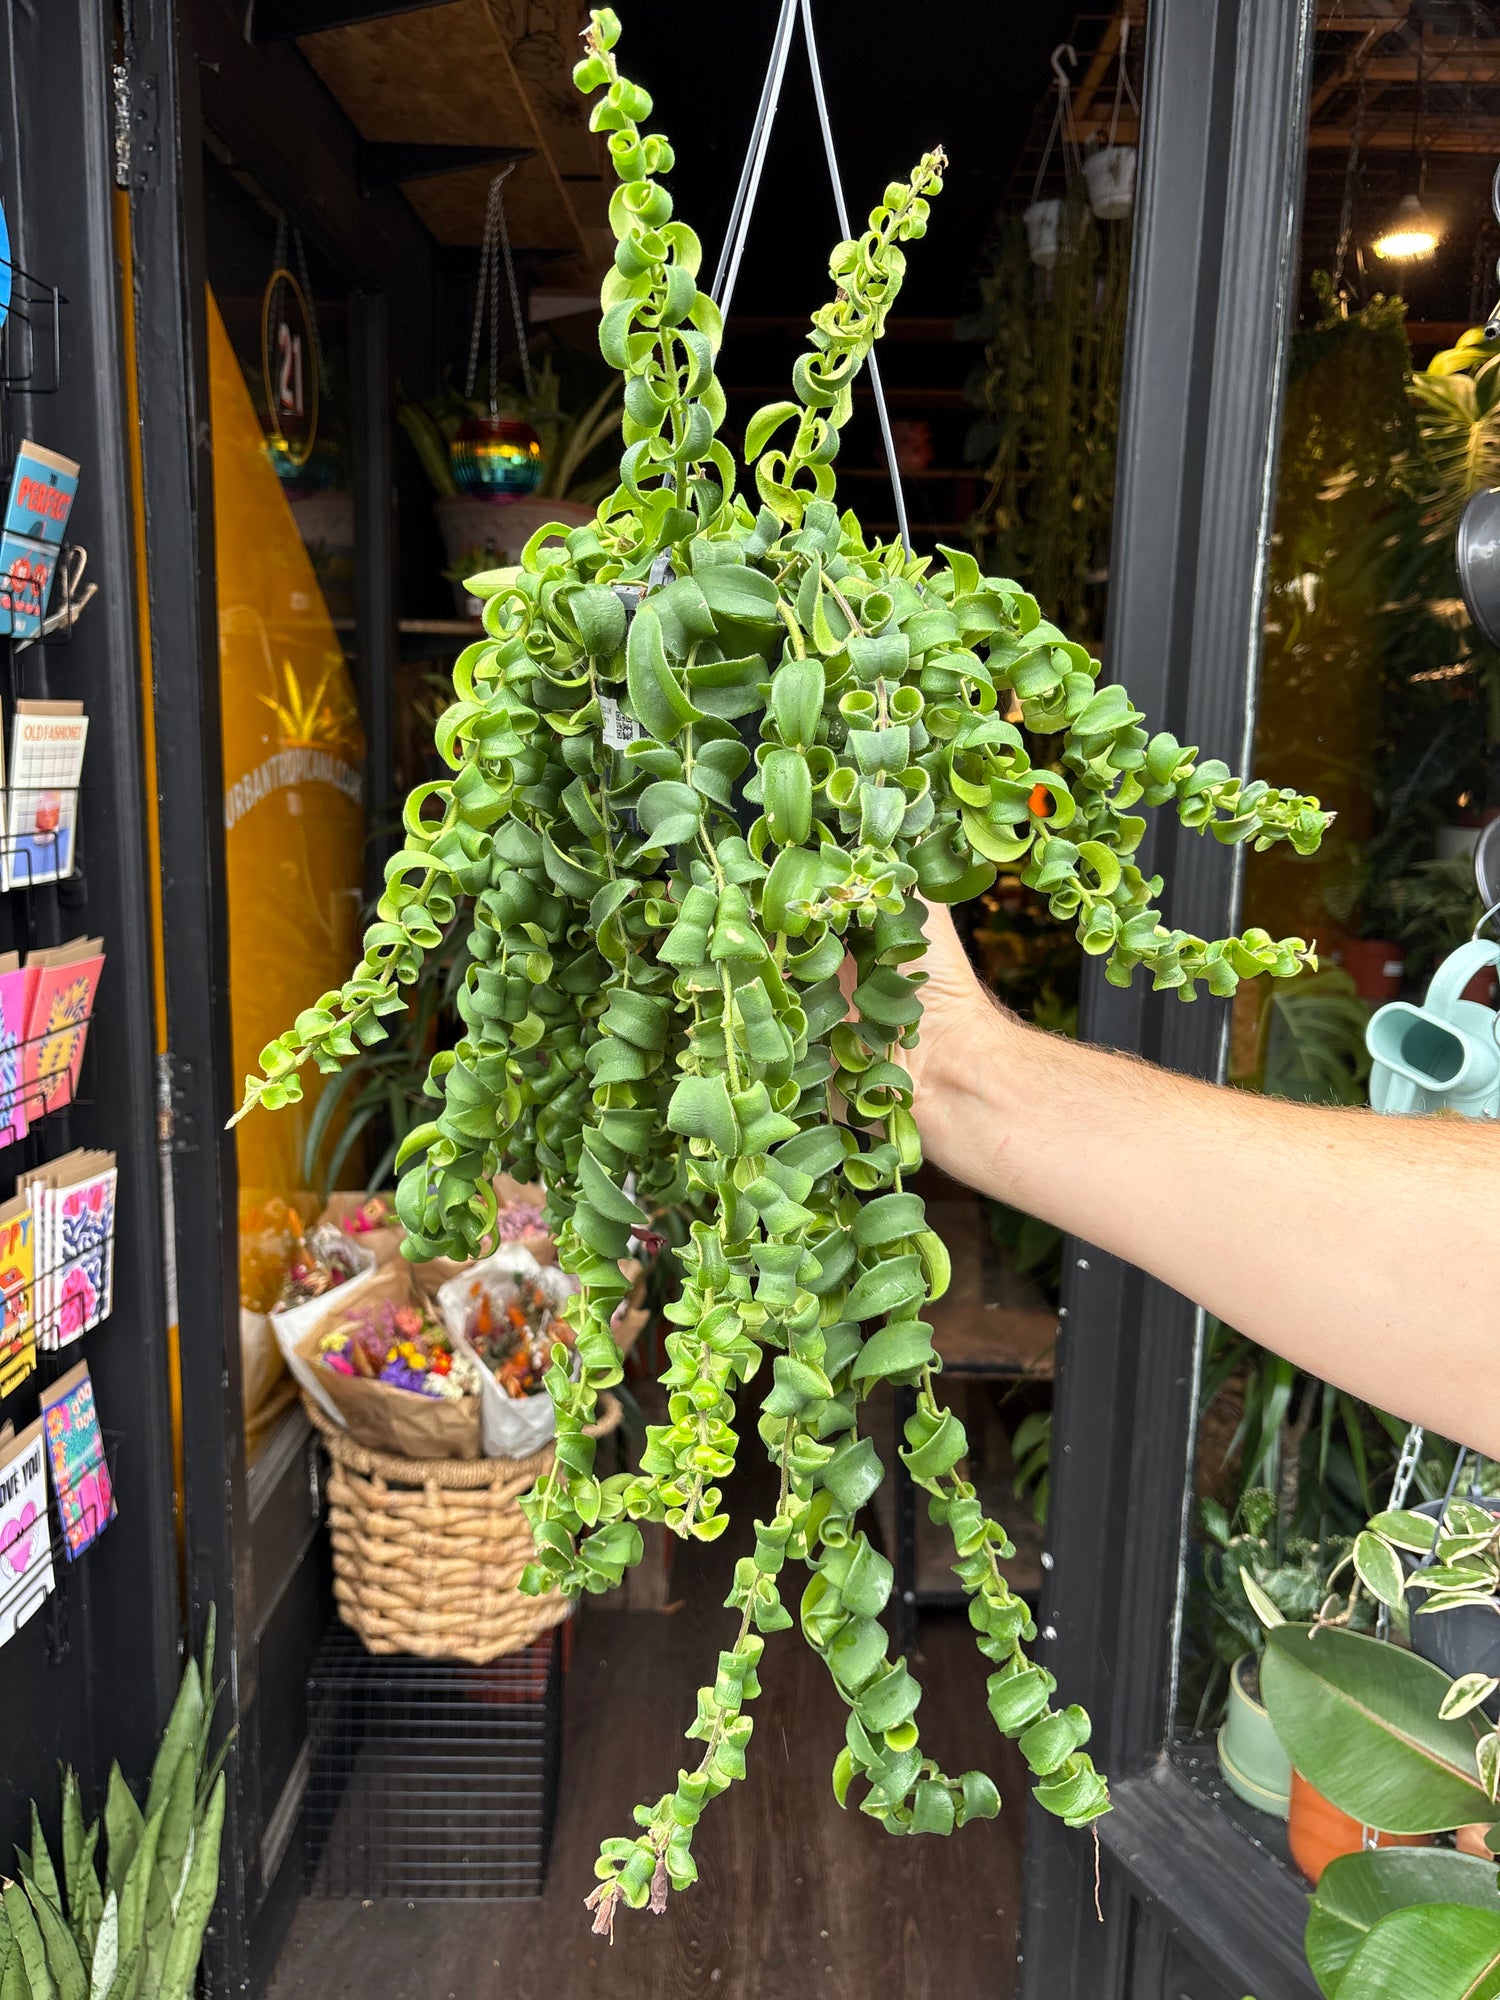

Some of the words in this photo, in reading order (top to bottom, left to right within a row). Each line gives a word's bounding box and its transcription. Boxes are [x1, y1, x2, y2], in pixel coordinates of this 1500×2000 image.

[279, 322, 304, 413] 21
[17, 475, 72, 522] PERFECT
[23, 723, 44, 741] OLD
[0, 1215, 32, 1263] PPY
[0, 1469, 20, 1508] OVE
[22, 1449, 41, 1489] YOU
